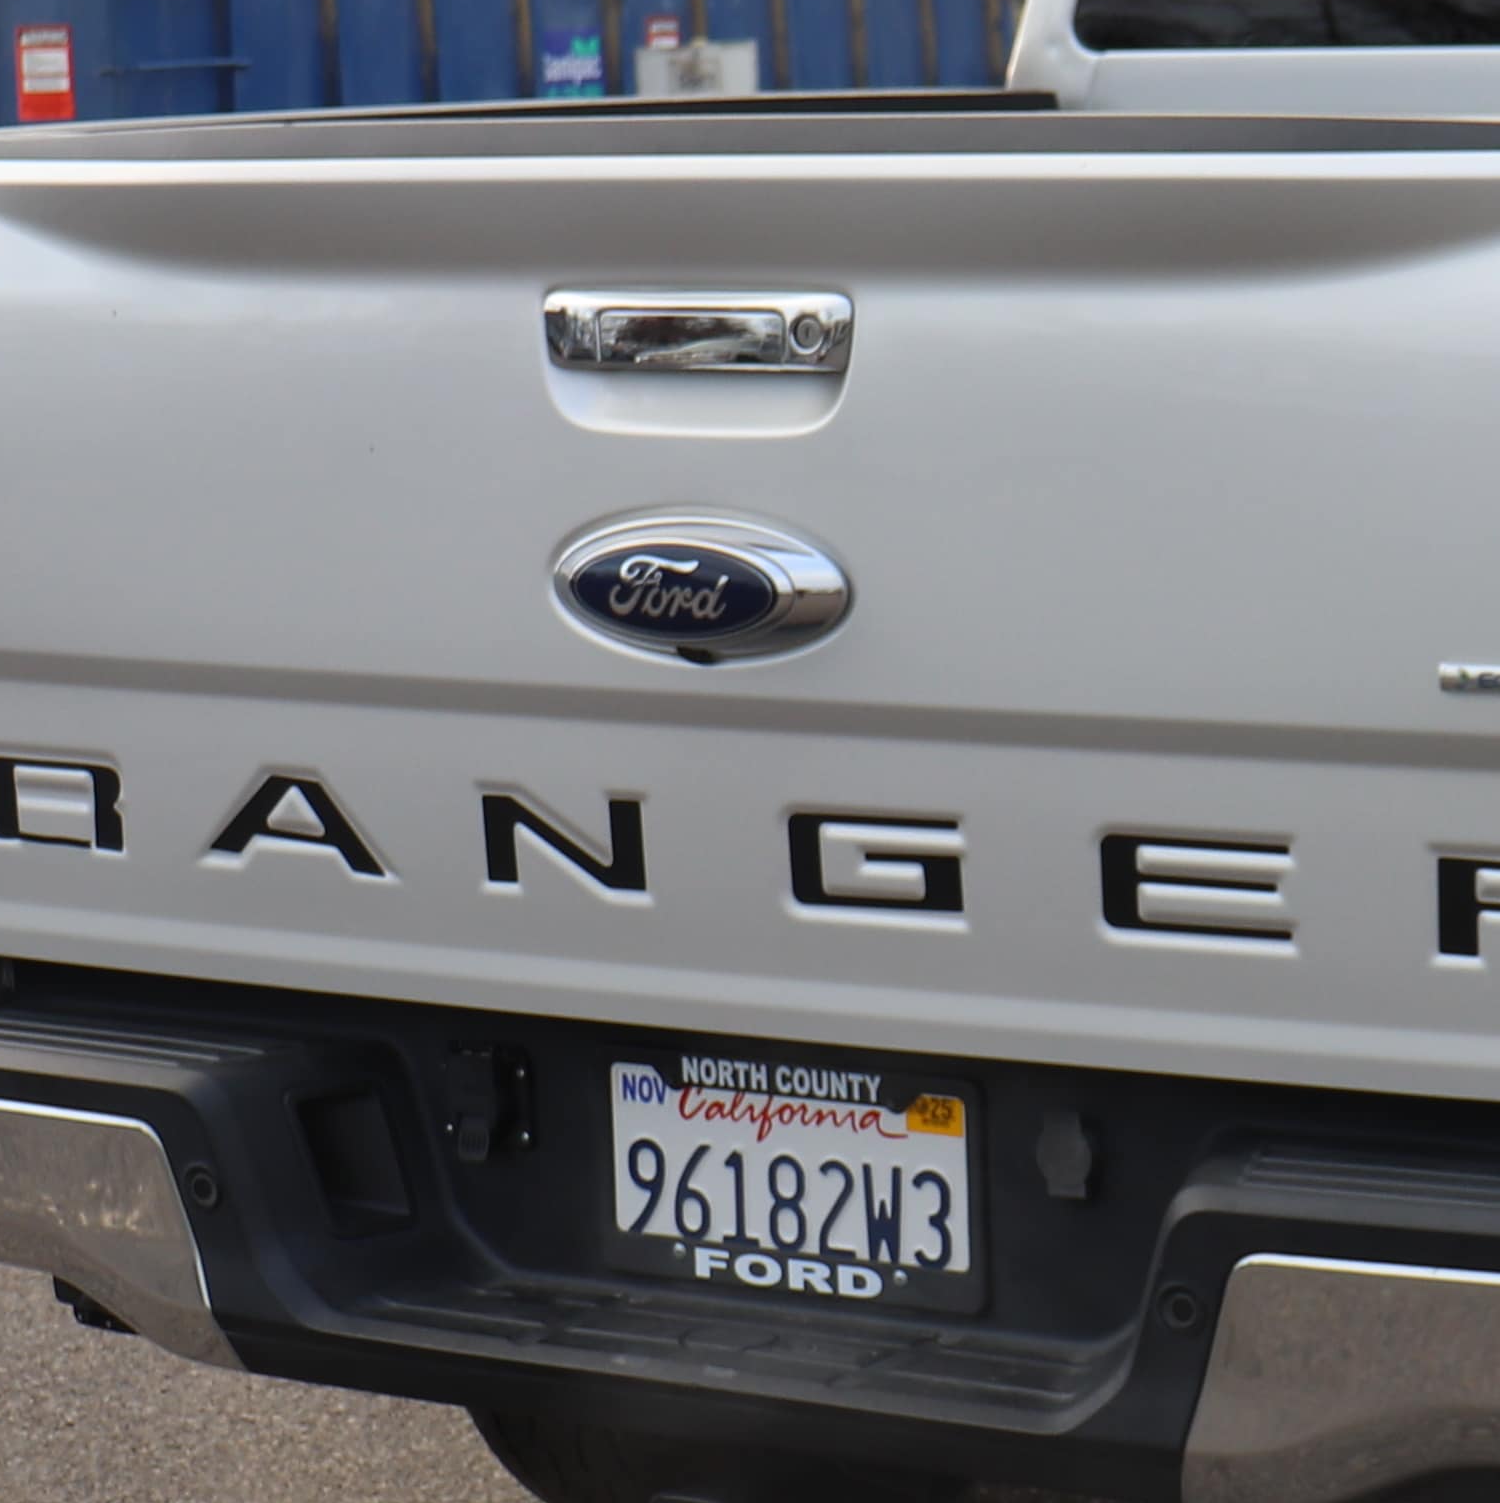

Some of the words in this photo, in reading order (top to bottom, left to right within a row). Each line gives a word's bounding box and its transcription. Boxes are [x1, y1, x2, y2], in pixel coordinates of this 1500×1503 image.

[608, 553, 730, 622] Ford
[621, 1071, 667, 1105] NOV
[681, 1056, 768, 1091] NORTH
[774, 1064, 882, 1104] COUNTY
[676, 1086, 909, 1143] California
[626, 1137, 954, 1271] 96182W3
[693, 1246, 884, 1298] FORD
